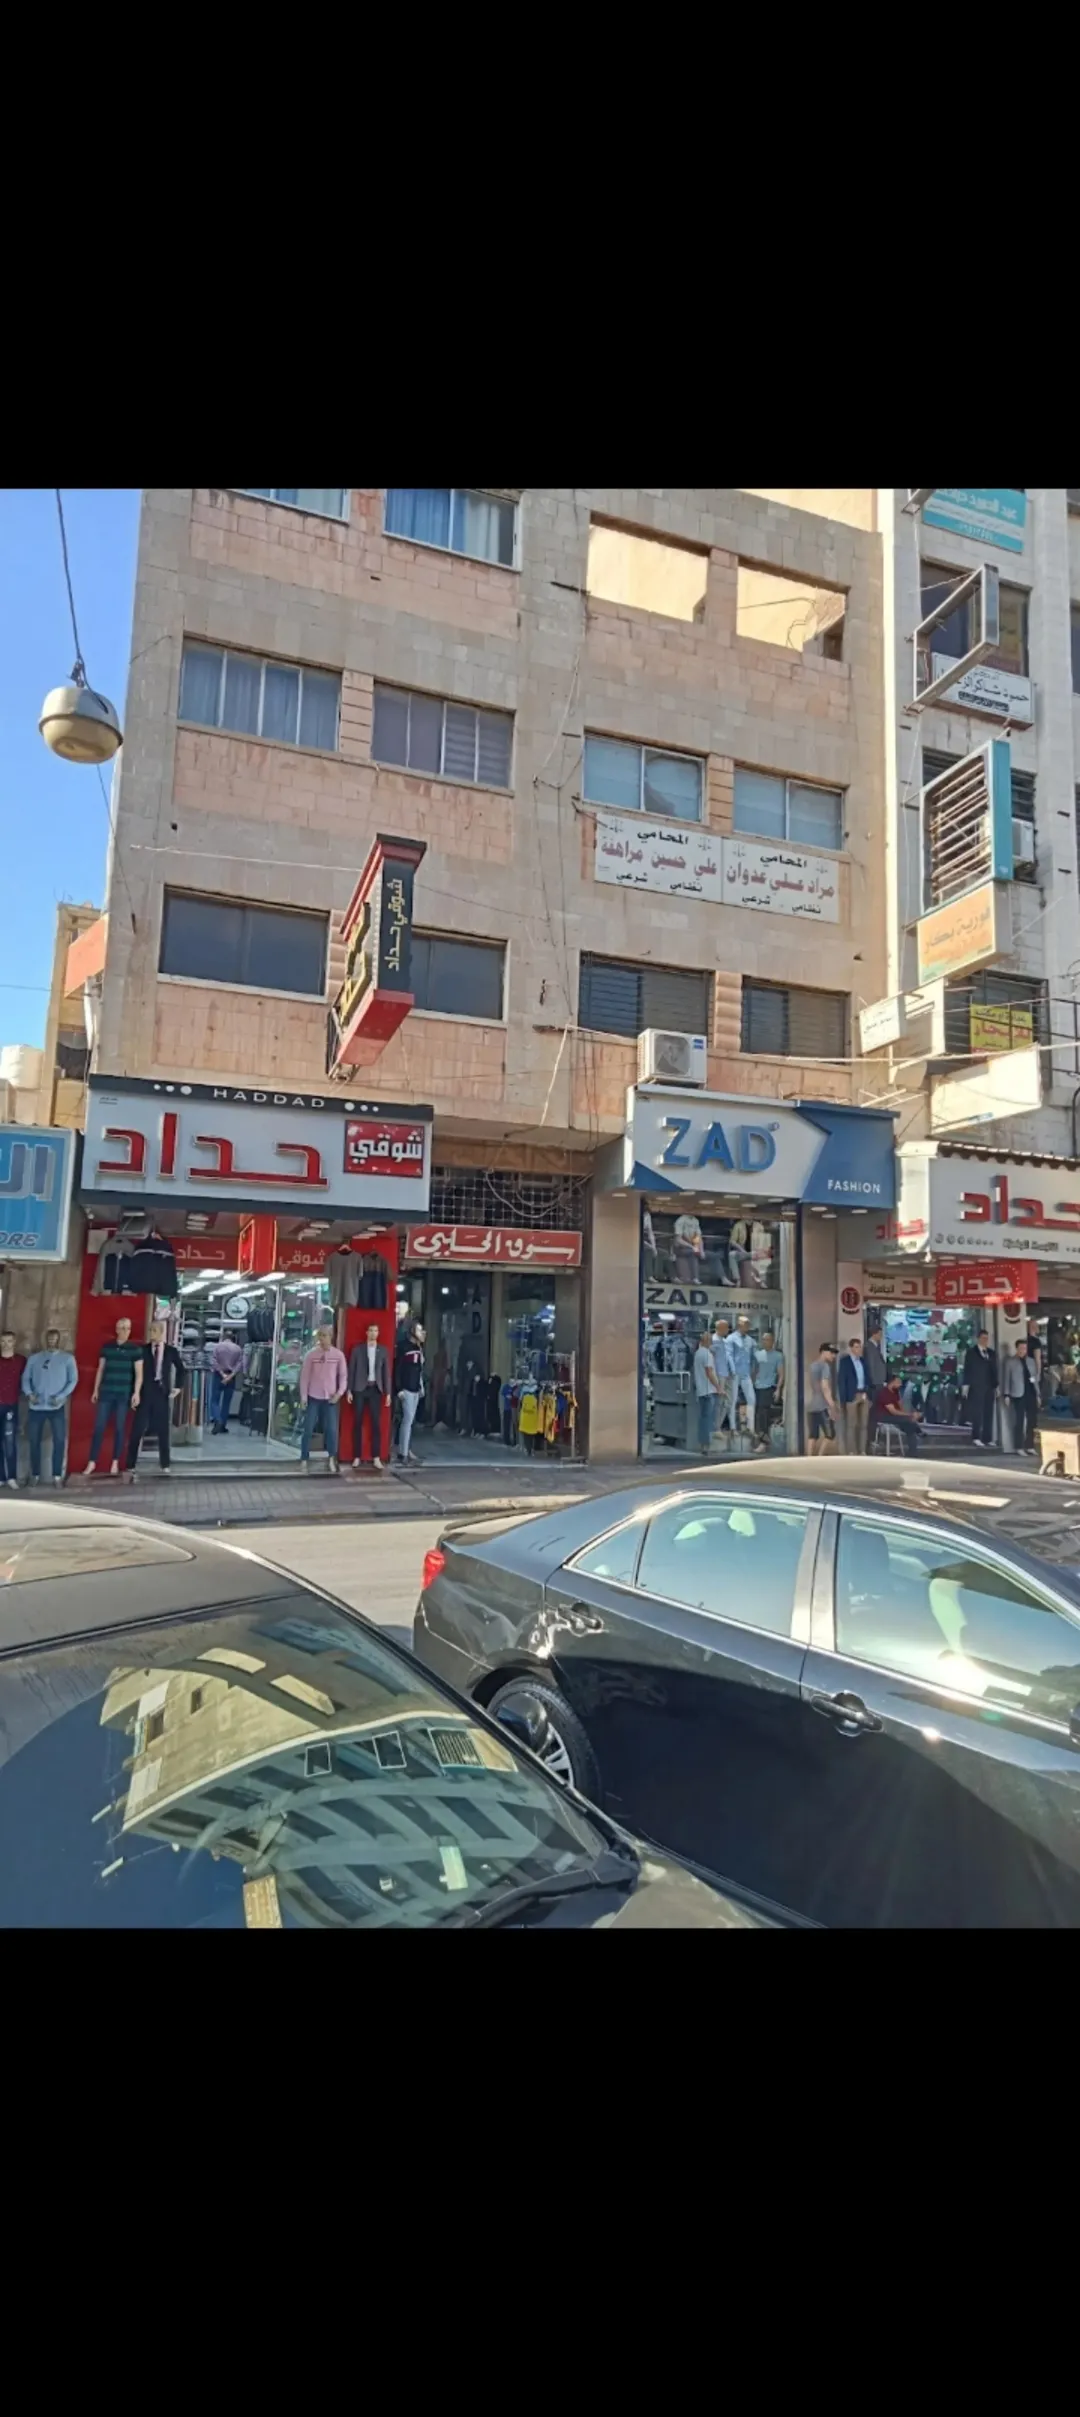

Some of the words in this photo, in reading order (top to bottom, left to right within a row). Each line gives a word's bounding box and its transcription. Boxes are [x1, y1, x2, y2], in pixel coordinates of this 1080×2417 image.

[637, 830, 689, 844] المحامي
[651, 851, 687, 871] حسين
[694, 857, 717, 877] علي
[760, 854, 808, 868] المحامي
[616, 872, 649, 885] شرعي
[726, 861, 767, 886] عدوان
[769, 872, 804, 897] علي
[808, 876, 835, 901] مراد
[386, 878, 409, 927] شوقي
[741, 895, 771, 907] شرعي
[384, 927, 401, 973] حداد
[213, 1087, 325, 1108] HADDAD
[97, 1111, 329, 1190] حداد
[349, 1130, 423, 1164] شوقي
[658, 1116, 777, 1173] ZAD
[827, 1178, 881, 1194] FASHION
[875, 1214, 926, 1240] حداد
[176, 1244, 226, 1261] حداد
[413, 1226, 502, 1258] الحلبي
[504, 1235, 575, 1261] سوق
[278, 1249, 326, 1269] شوقي
[944, 1275, 1013, 1297] حداد
[645, 1287, 709, 1307] ZAD
[714, 1300, 770, 1311] FASHION
